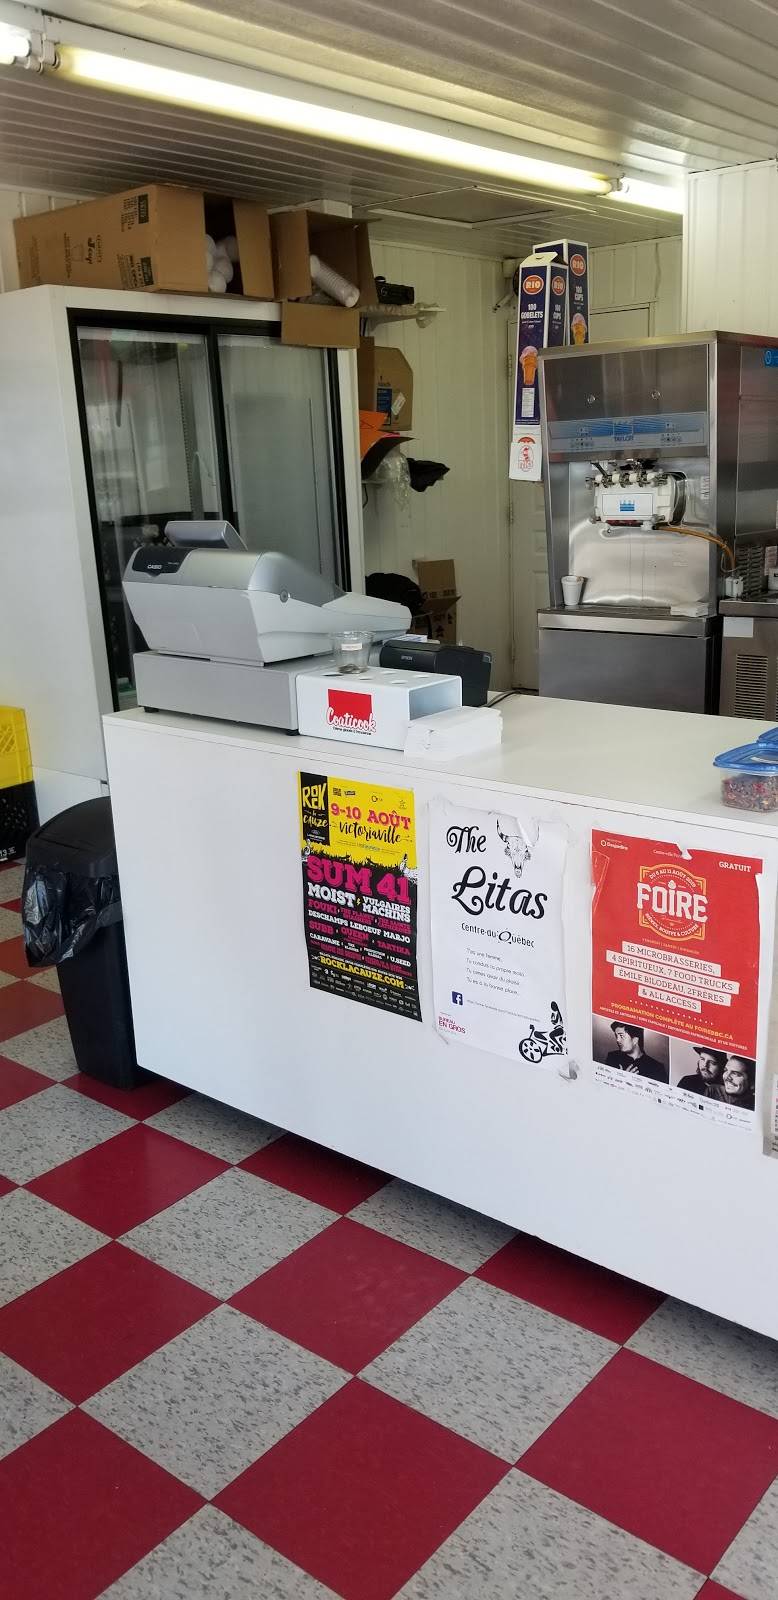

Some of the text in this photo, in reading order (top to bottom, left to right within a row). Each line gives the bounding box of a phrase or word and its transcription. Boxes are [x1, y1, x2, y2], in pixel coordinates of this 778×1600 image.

[525, 281, 541, 289] RIO
[521, 311, 544, 320] GOBELETS
[326, 706, 377, 733] Coaticook
[330, 803, 411, 830] 9-10 AOÛT
[446, 826, 487, 853] The
[307, 855, 411, 906] SUM 41
[718, 861, 752, 873] GRATUIT
[307, 882, 411, 914] MOIST VULGAIRES
[451, 865, 548, 919] Litas
[637, 880, 708, 923] FOIRE
[308, 910, 349, 927] DESCHAMPS
[383, 928, 411, 943] MARJO
[362, 903, 411, 923] MACHINS
[319, 955, 405, 989] ROCKLACAUZE.COM
[611, 953, 617, 962] 4
[618, 955, 668, 976] SPIRITUEUX,
[673, 971, 697, 983] FOOD
[698, 977, 734, 991] TRUCKS
[626, 944, 716, 974] 16 MICROBRASSERIES,
[618, 968, 725, 1004] ÉMILE BILODEAU, 2FRÈRES
[649, 990, 665, 1001] ALL
[666, 995, 698, 1010] ACCESS
[685, 1022, 694, 1030] AU
